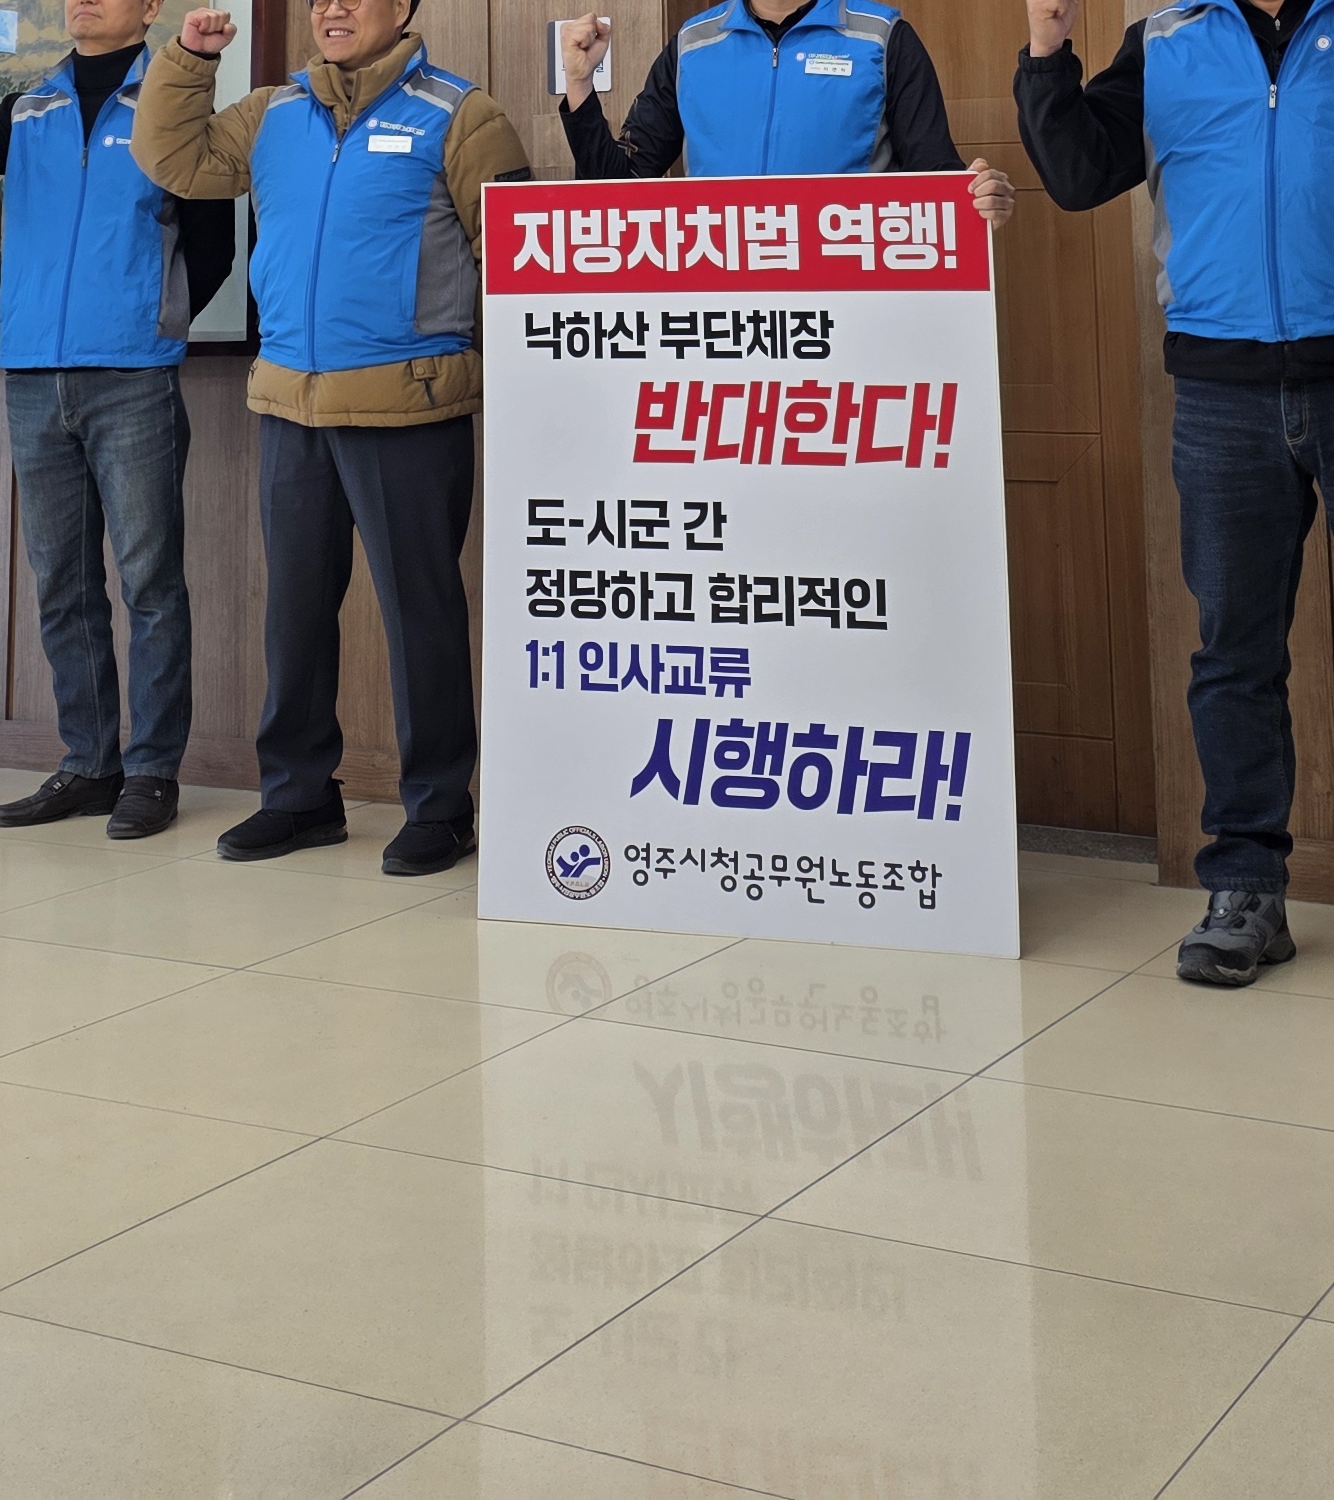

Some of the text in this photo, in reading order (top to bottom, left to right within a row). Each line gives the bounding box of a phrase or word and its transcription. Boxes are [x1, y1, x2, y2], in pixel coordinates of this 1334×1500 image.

[513, 201, 958, 274] 지방자치법 역행!
[524, 309, 834, 360] 낙하산 부단체장
[632, 379, 958, 469] 반대한다!
[526, 498, 727, 551] 도-시군 간
[525, 568, 888, 631] 정당하고 합리적인
[525, 639, 752, 699] 1:1 인사교류
[629, 717, 972, 822] 시행하라!
[623, 842, 943, 910] 영주시청공무원노동조합
